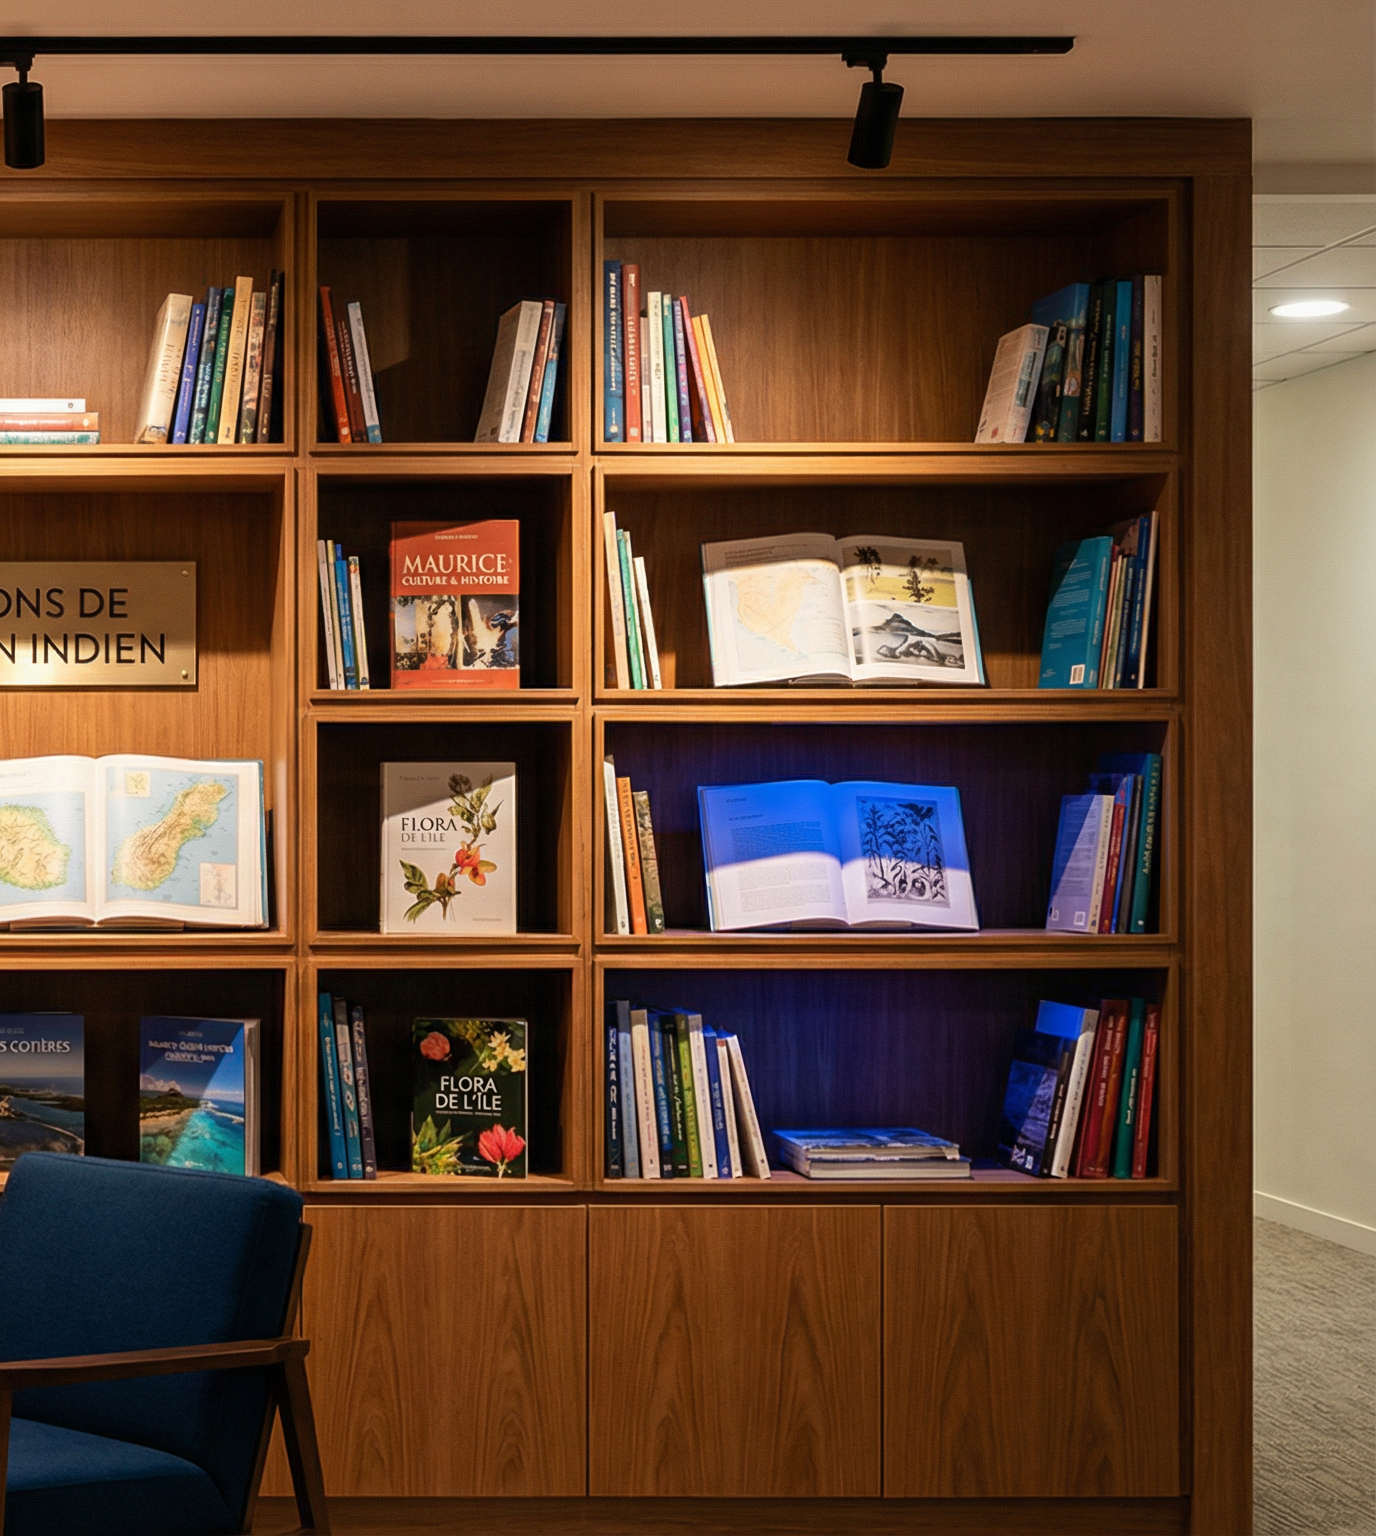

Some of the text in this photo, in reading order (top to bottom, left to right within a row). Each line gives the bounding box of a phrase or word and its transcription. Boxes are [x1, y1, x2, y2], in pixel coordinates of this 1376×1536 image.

[79, 587, 128, 618] DE
[31, 632, 166, 665] INDIEN
[440, 1075, 498, 1093] FLORA
[435, 1093, 459, 1110] DE
